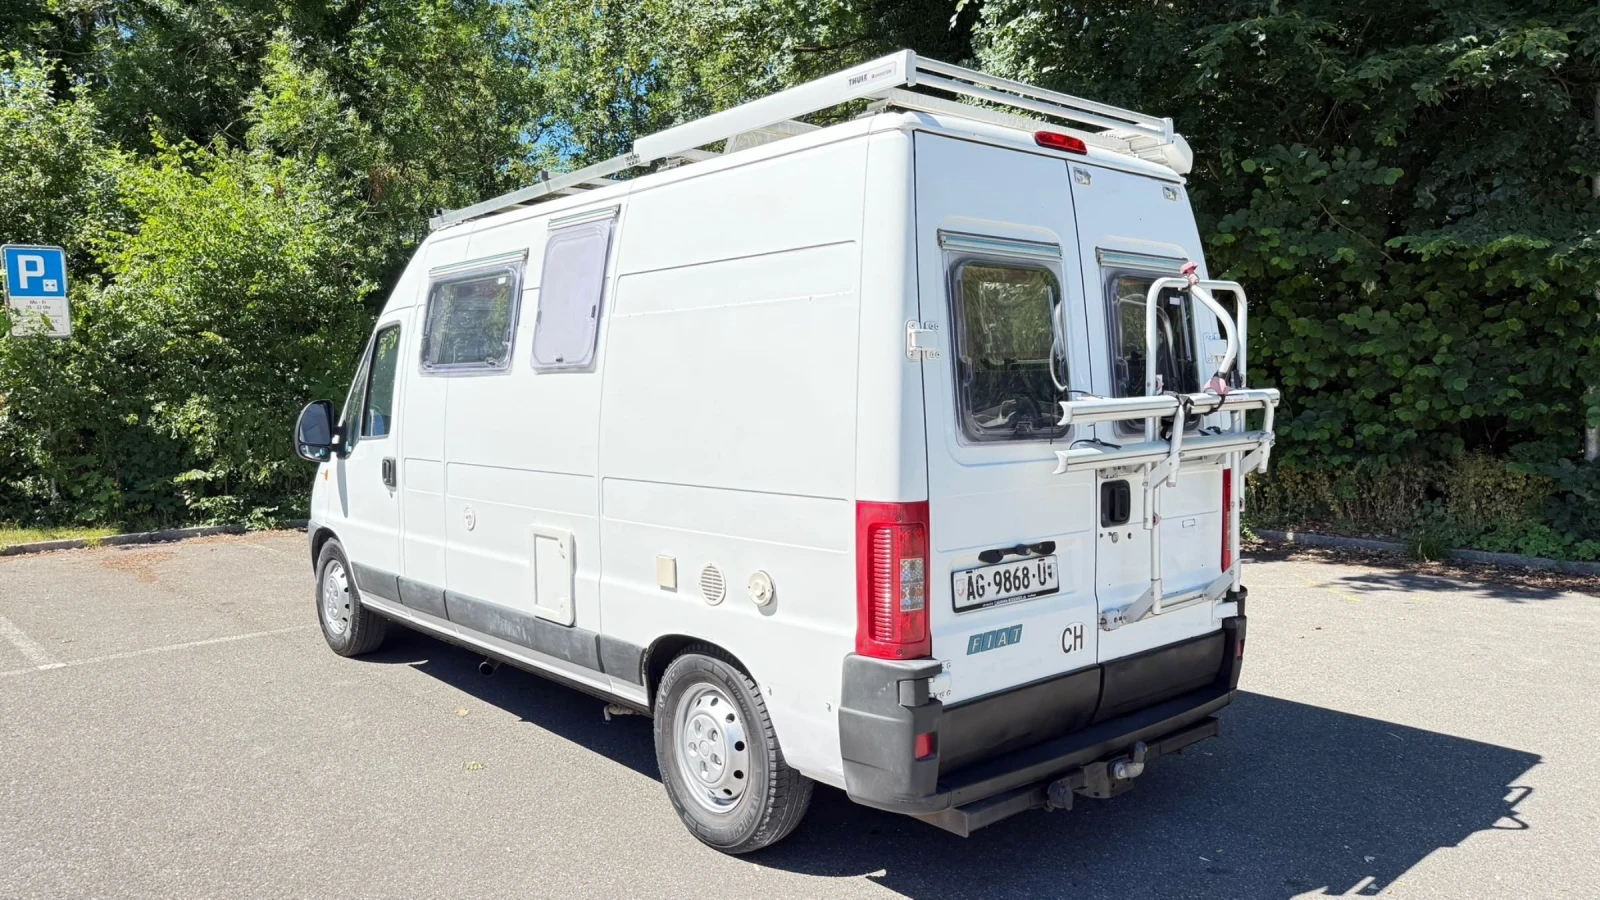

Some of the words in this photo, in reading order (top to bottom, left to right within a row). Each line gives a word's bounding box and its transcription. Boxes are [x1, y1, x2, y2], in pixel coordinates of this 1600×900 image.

[848, 74, 868, 86] THULE
[17, 254, 45, 289] P
[970, 627, 1021, 653] FIAT
[1062, 624, 1084, 654] CH
